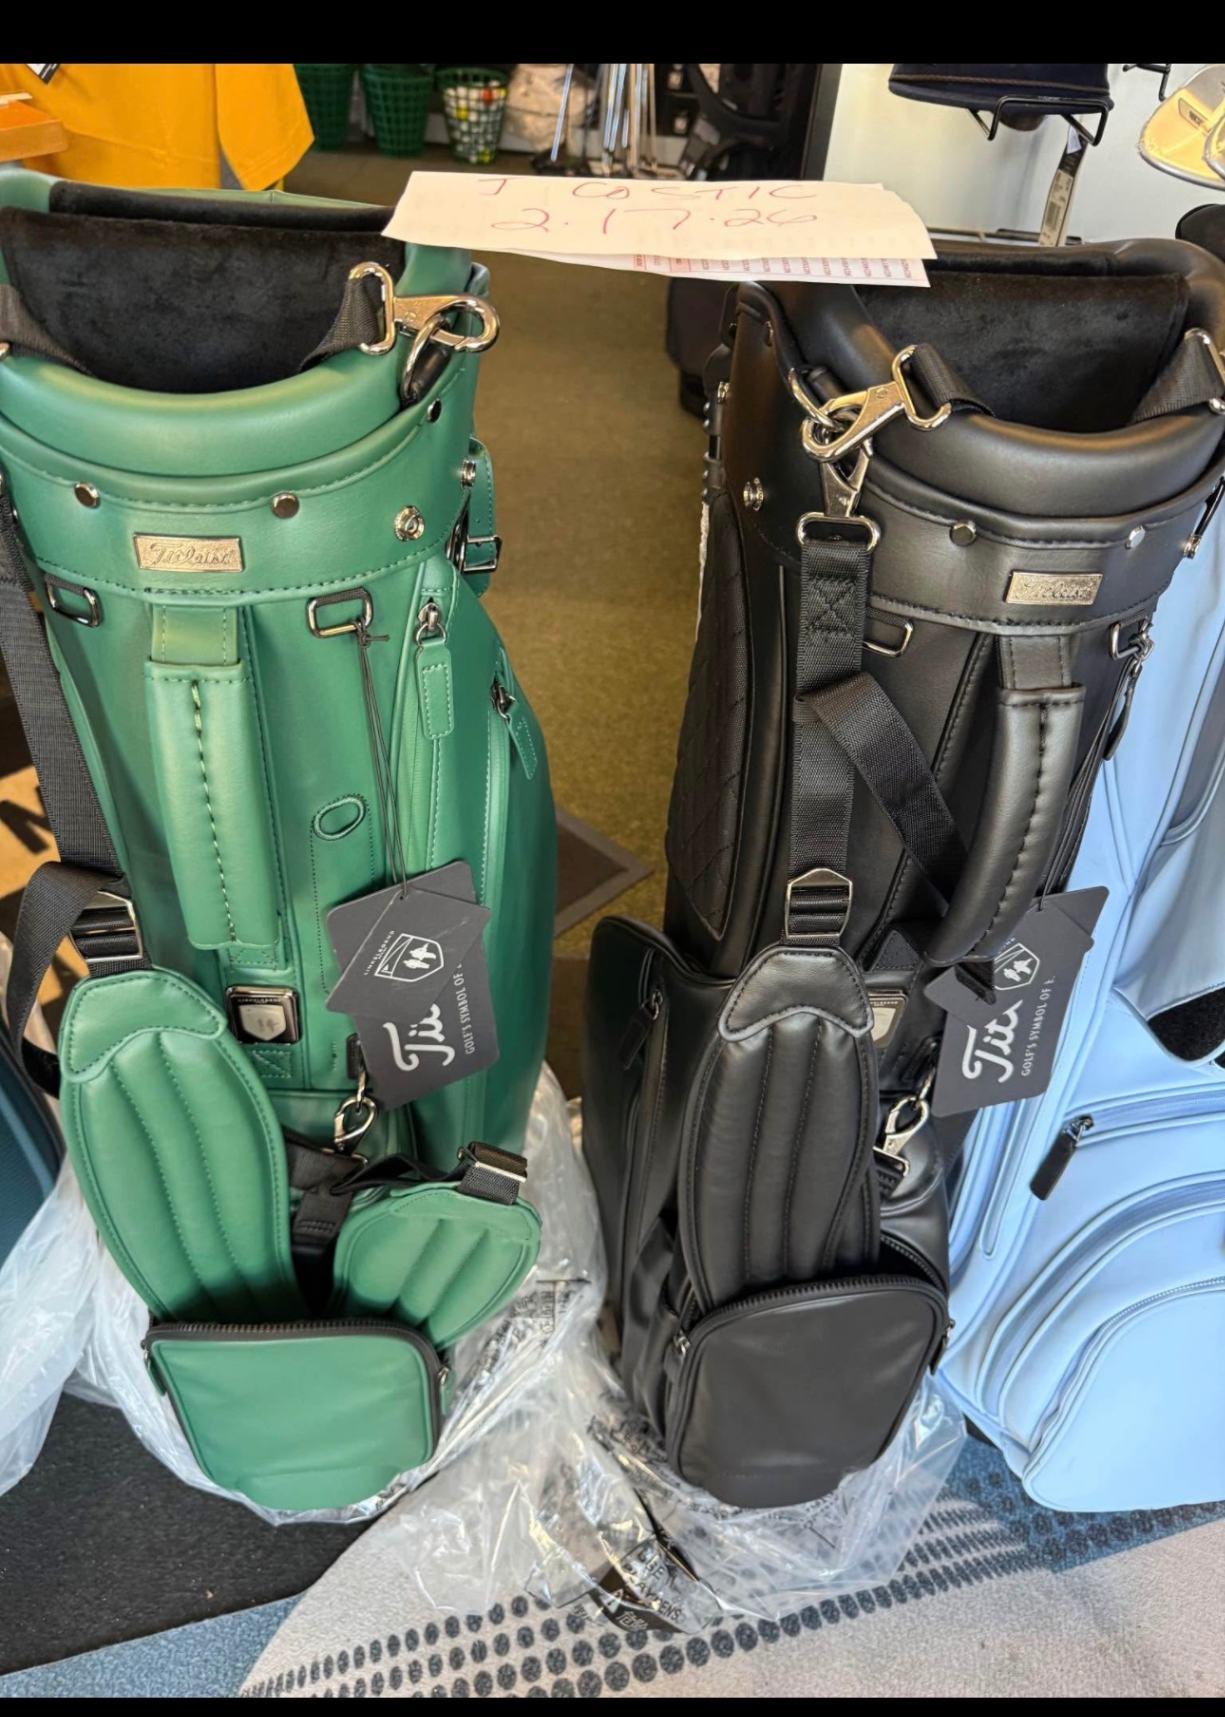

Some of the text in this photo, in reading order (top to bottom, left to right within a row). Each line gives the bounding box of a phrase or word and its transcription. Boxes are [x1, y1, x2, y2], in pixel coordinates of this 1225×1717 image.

[453, 973, 465, 987] OF
[1040, 987, 1052, 1001] OF
[456, 987, 471, 1024] SYMBOL
[1029, 1002, 1048, 1042] SYMBOL
[461, 1024, 476, 1055] GOLF'S
[1021, 1043, 1038, 1077] GOLF'S
